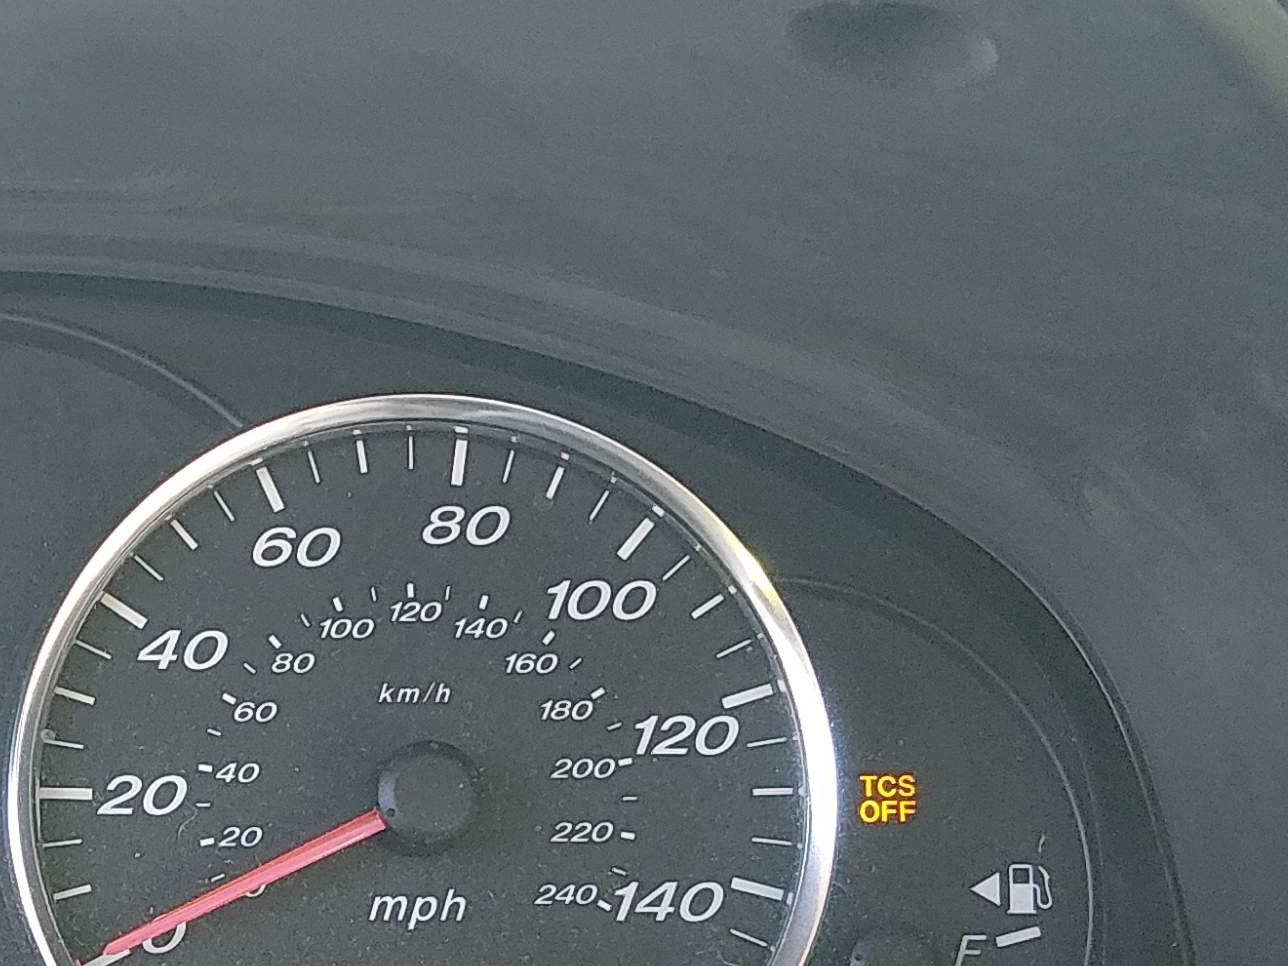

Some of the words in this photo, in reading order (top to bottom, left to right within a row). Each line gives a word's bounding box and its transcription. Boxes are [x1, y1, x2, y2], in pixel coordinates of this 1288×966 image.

[422, 505, 510, 546] 80
[252, 526, 341, 568] 60
[547, 580, 657, 621] 100
[390, 601, 442, 622] 120
[320, 618, 375, 639] 100
[455, 618, 508, 639] 140
[137, 629, 228, 670] 40
[271, 653, 315, 674] 80
[506, 653, 558, 674] 160
[378, 682, 451, 703] km/h
[234, 701, 278, 722] 60
[541, 699, 594, 721] 180
[635, 715, 740, 756] 120
[215, 762, 260, 783] 40
[550, 758, 616, 779] 200
[96, 774, 188, 816] 20
[860, 775, 916, 798] TCS
[860, 801, 916, 823] OFF
[223, 826, 263, 847] 20
[550, 821, 614, 842] 220
[534, 884, 598, 905] 240
[614, 881, 724, 922] 140
[369, 888, 466, 930] mph
